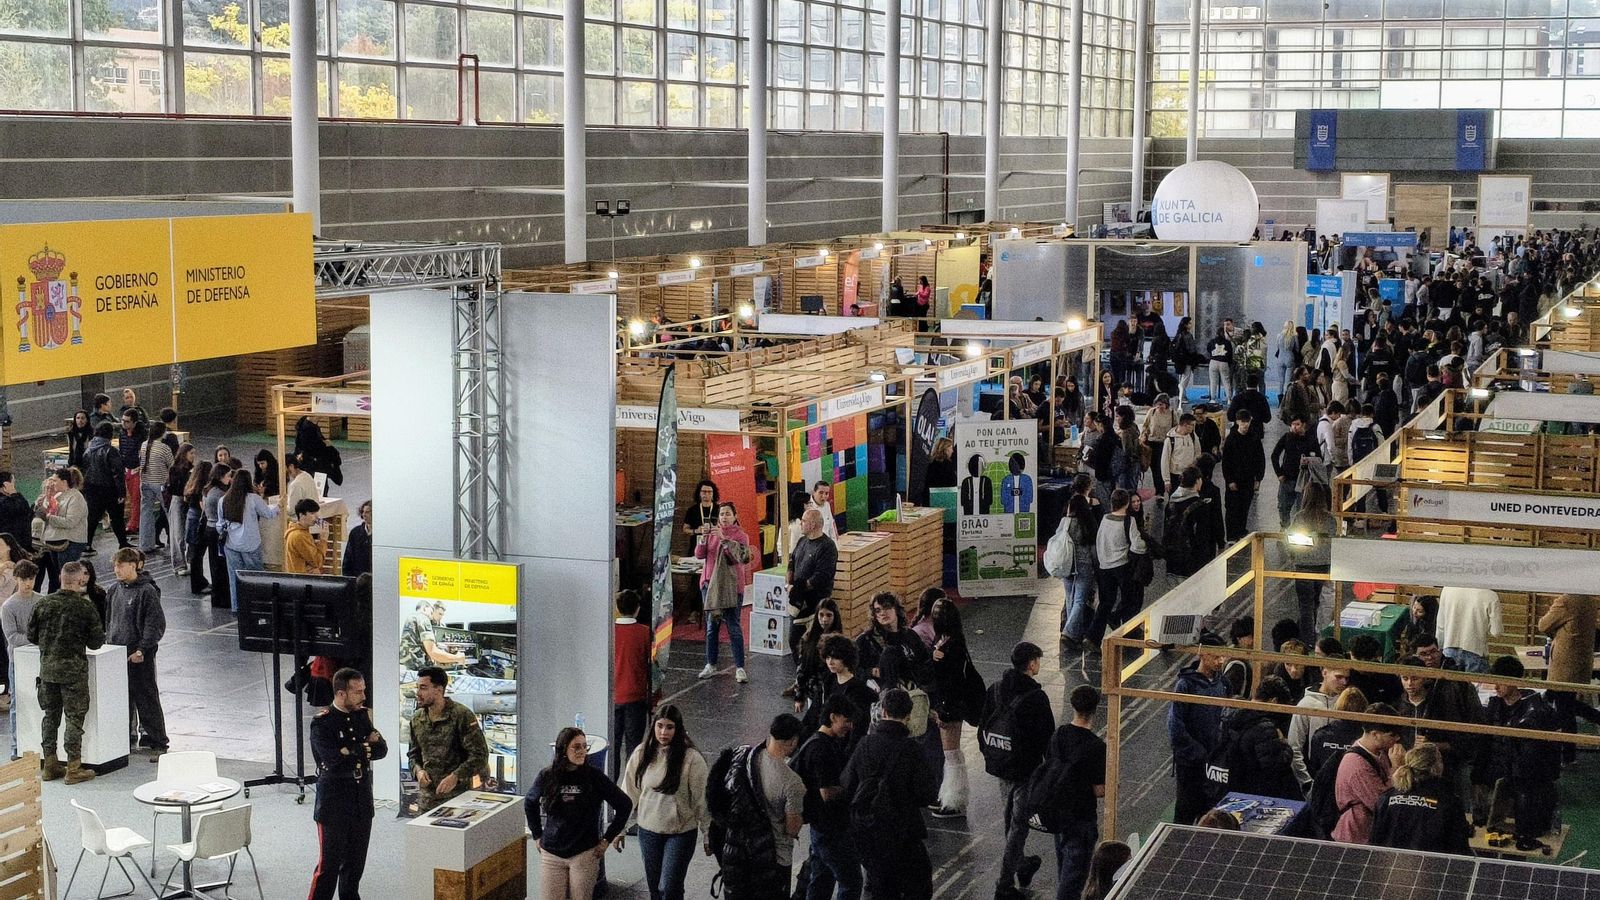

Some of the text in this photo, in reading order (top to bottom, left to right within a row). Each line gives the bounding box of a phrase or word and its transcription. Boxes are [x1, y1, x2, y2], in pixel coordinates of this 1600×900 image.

[1160, 199, 1196, 211] XUNTA
[1159, 212, 1223, 223] DE GALICIA
[186, 265, 246, 283] MINISTERIO
[95, 272, 159, 291] GOBIERNO
[96, 290, 159, 312] DE ESPAÑA
[187, 286, 250, 304] DE DEFENSA
[976, 427, 1018, 437] PON CARA
[965, 437, 1029, 448] AO TEU FUTURO
[1490, 502, 1522, 513] UNED
[961, 518, 989, 530] GRAO
[982, 730, 1012, 751] VANS
[1323, 742, 1353, 752] POLIC
[1205, 763, 1229, 783] VANS
